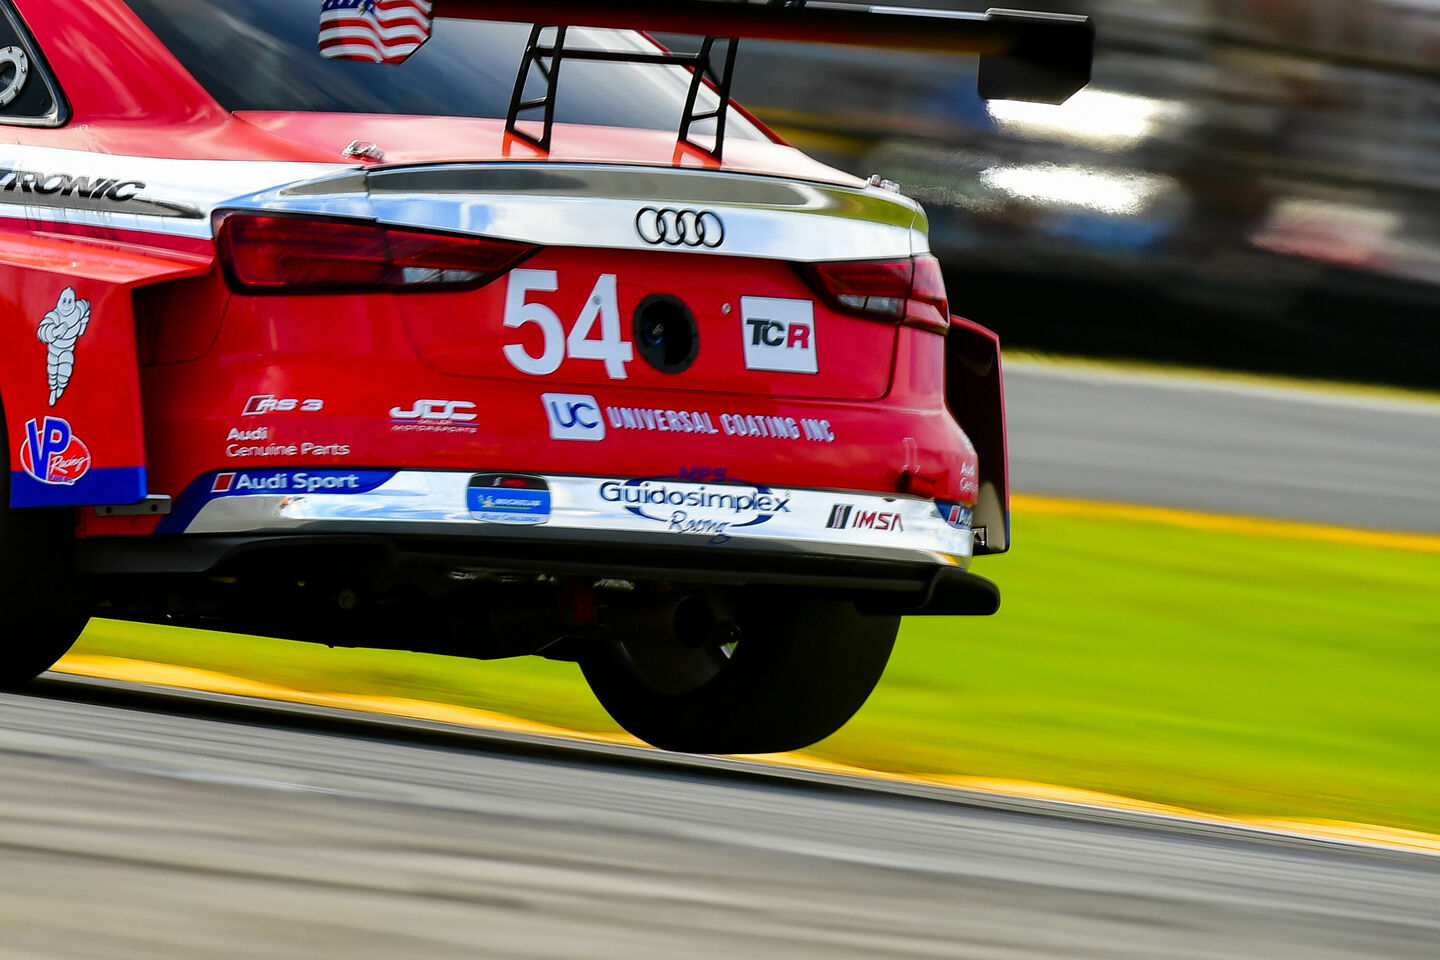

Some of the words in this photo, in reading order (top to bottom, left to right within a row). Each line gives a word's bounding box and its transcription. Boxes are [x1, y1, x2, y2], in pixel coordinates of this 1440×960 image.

[502, 268, 634, 380] 54
[746, 317, 810, 349] TCR
[300, 398, 324, 411] 3
[388, 399, 478, 420] JDC
[550, 400, 599, 429] UC
[226, 427, 268, 441] Audi
[605, 406, 719, 434] UNIVERSAL
[719, 413, 801, 440] COATING
[800, 418, 836, 442] INC
[26, 416, 72, 481] VP
[226, 443, 298, 458] Genuine
[301, 443, 351, 456] Parts
[235, 472, 293, 490] Audi
[294, 473, 360, 492] Sport
[678, 466, 728, 481] MPS
[601, 481, 792, 513] Guidosimplex
[851, 509, 905, 532] IMSA
